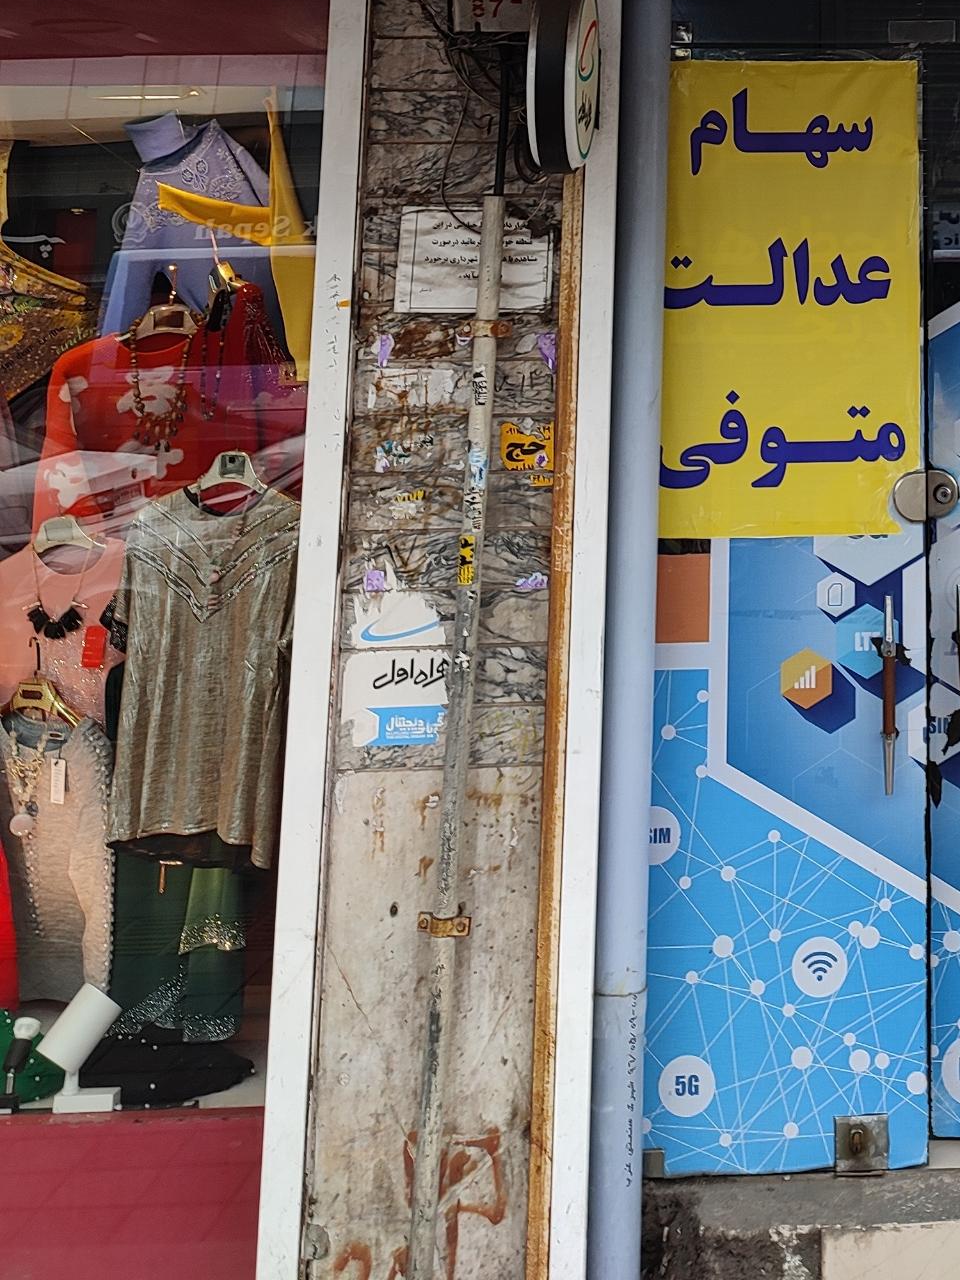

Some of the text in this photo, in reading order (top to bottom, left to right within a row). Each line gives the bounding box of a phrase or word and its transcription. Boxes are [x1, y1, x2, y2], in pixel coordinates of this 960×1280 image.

[690, 87, 873, 176] سهام
[664, 236, 892, 310] عدالت
[659, 389, 906, 489] متوفی
[373, 657, 414, 689] اول
[674, 1074, 701, 1097] 5G
